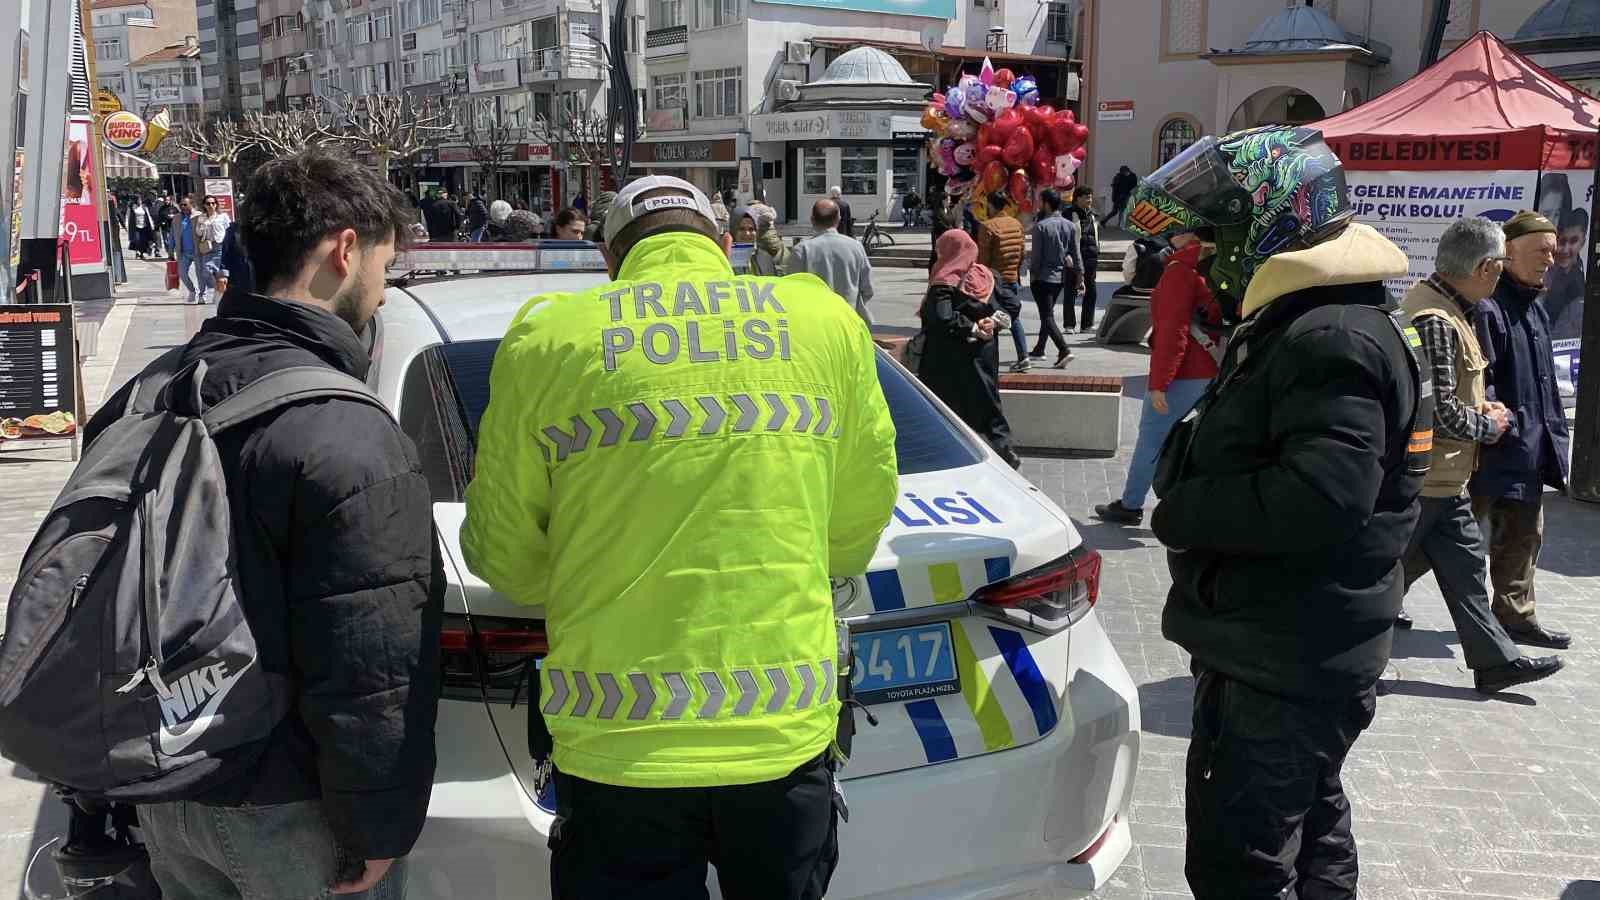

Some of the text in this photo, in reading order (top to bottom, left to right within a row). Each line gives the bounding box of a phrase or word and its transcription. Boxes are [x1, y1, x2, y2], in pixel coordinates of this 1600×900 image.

[108, 121, 141, 129] BURGER
[108, 129, 141, 138] KING
[1351, 138, 1500, 161] BELEDİYESİ
[1355, 184, 1405, 198] GELEN
[1408, 182, 1524, 200] EMANETİNE
[1378, 203, 1408, 220] ÇIK
[1410, 204, 1464, 218] BOLU!
[65, 221, 95, 242] 9TL
[893, 491, 1002, 527] LİSİ
[158, 661, 234, 729] NIKE
[887, 689, 914, 699] TOYOTA
[914, 687, 935, 696] PLAZA
